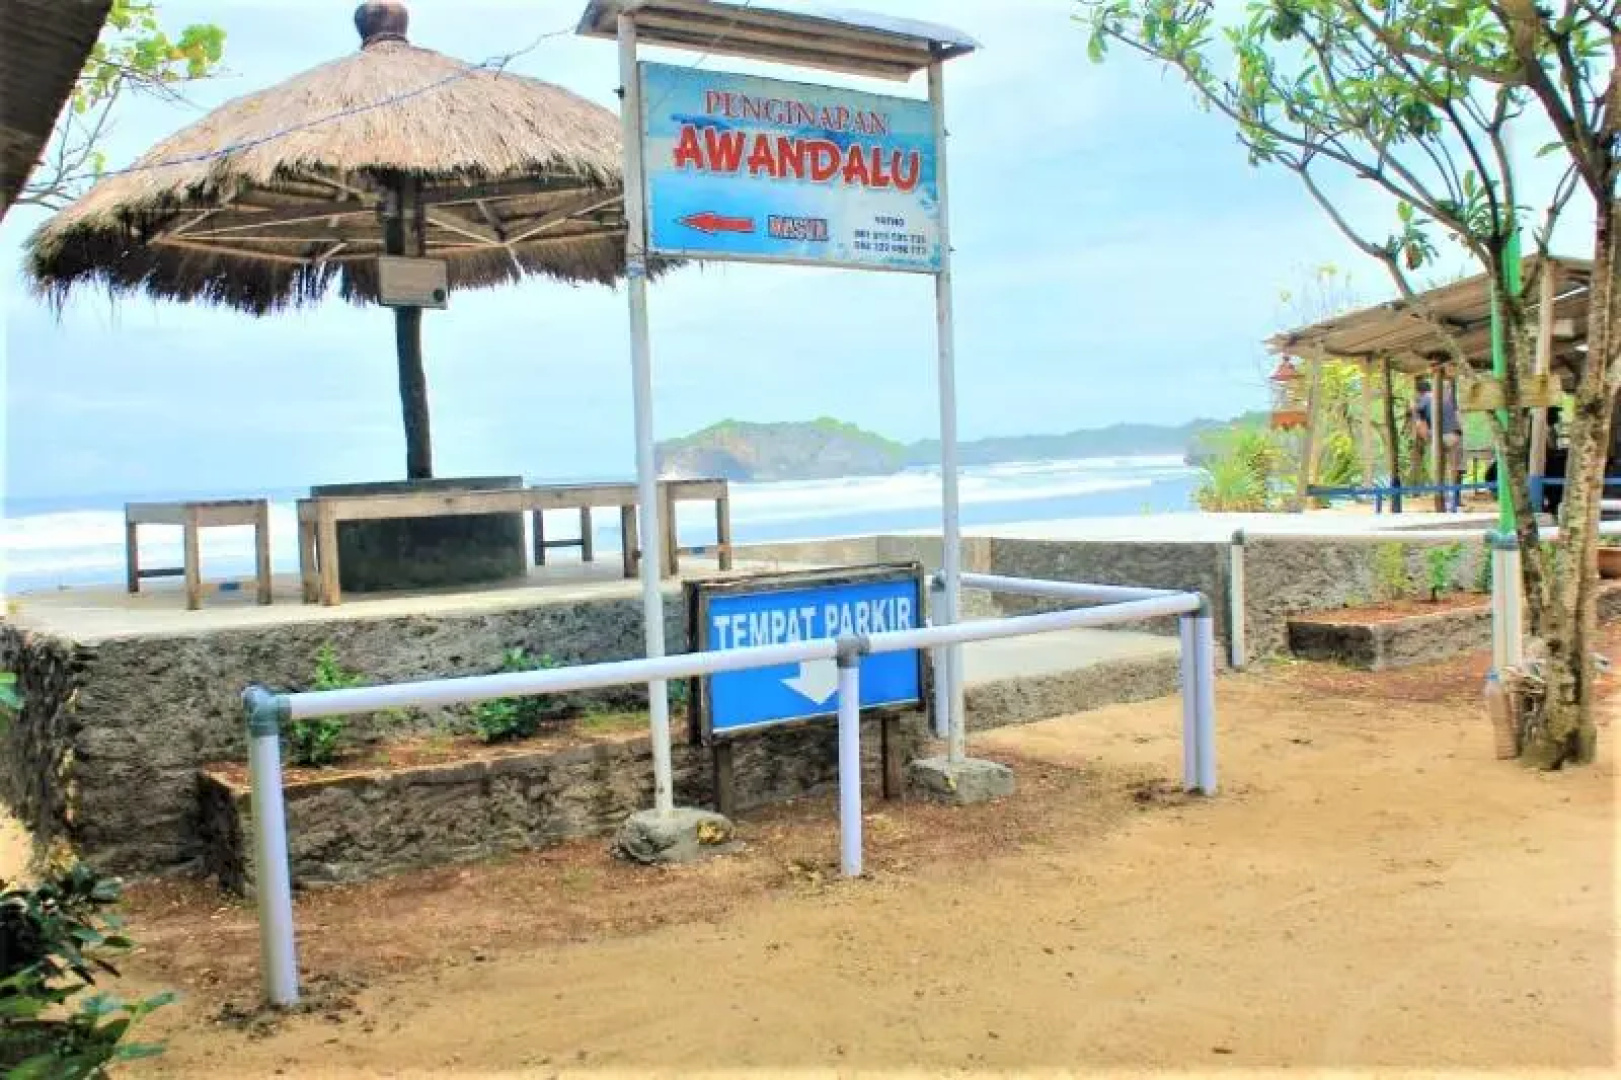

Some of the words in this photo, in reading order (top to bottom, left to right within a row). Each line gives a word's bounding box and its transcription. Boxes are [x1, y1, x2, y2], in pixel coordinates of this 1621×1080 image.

[706, 90, 888, 136] PENGINAPAN
[672, 124, 921, 191] AWANDALU
[713, 607, 816, 650] TEMPAT
[825, 597, 911, 640] PARKIR
